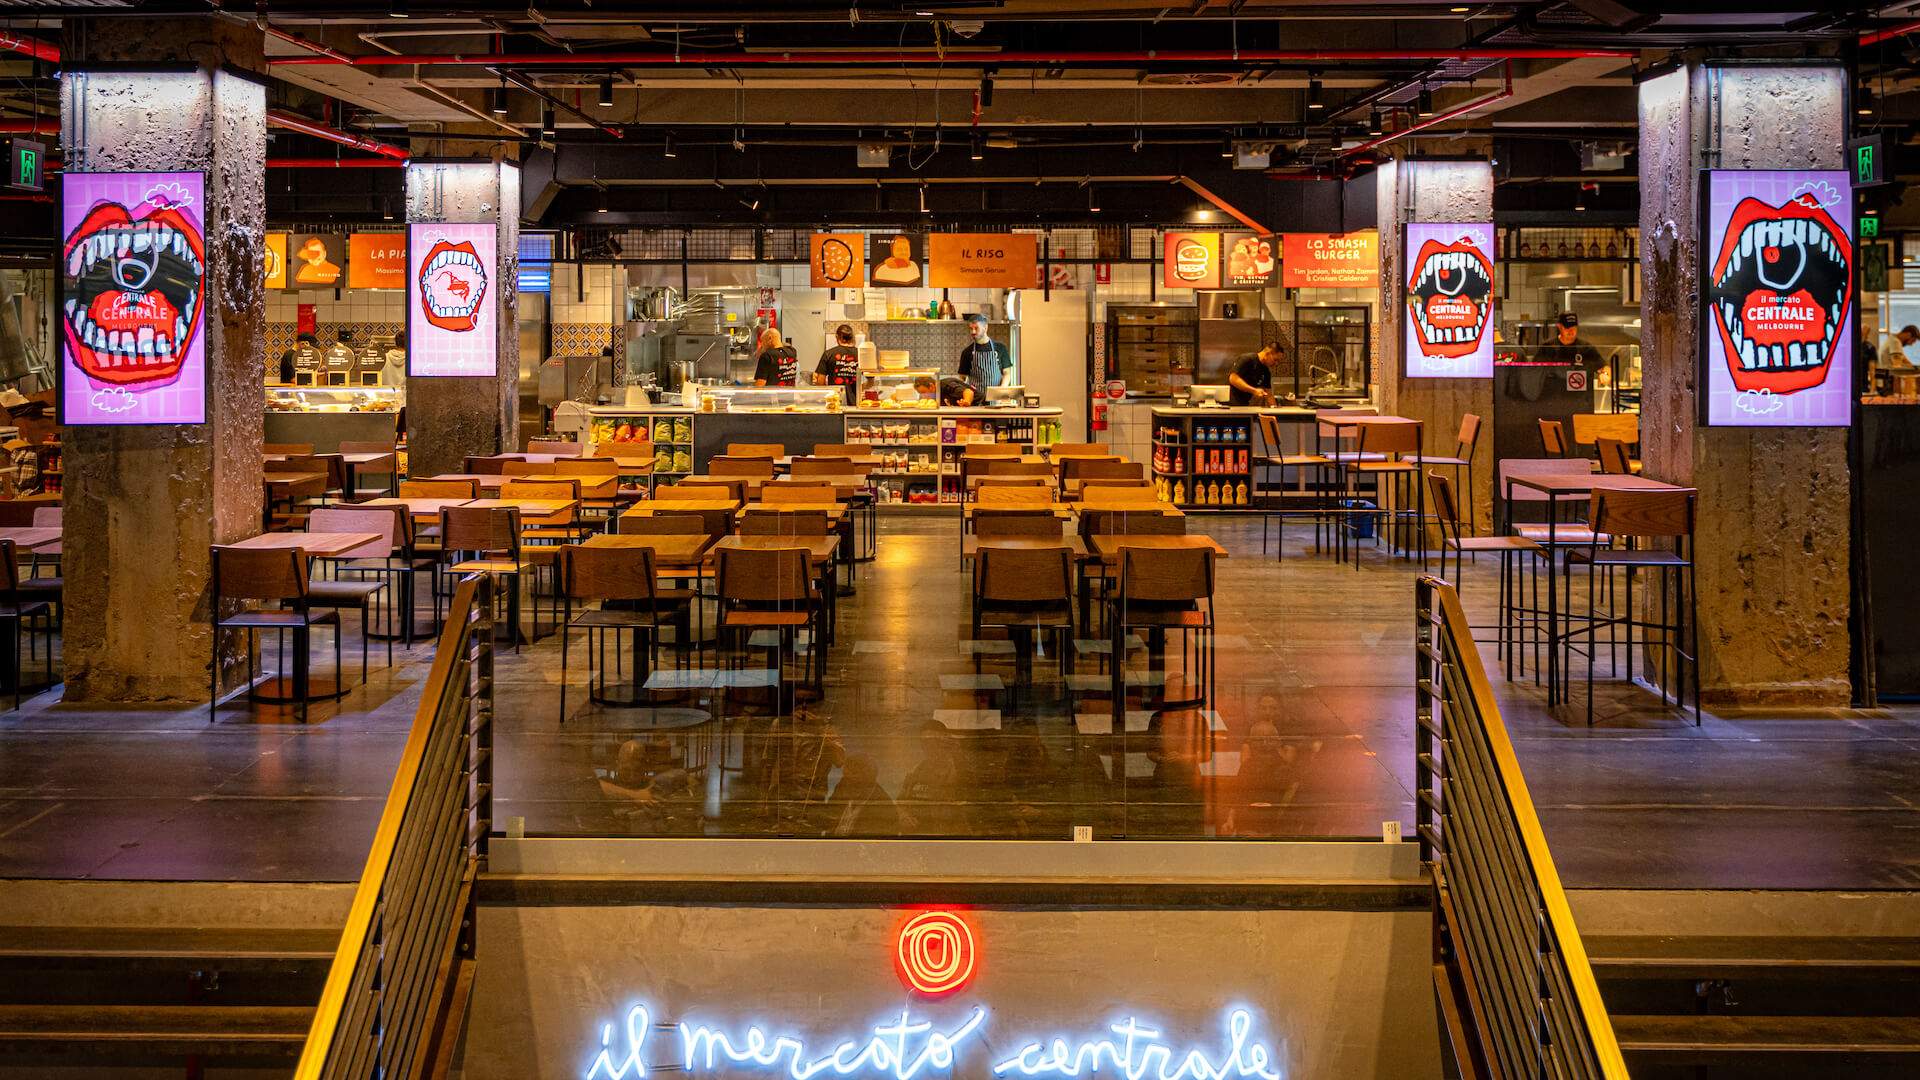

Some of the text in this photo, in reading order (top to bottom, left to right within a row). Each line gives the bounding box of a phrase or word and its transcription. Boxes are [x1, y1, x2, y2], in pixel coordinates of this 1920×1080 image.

[1307, 239, 1367, 249] LO SMASH
[371, 249, 385, 259] LA
[962, 248, 1004, 258] IL RISO
[1314, 250, 1361, 260] BURGER
[113, 292, 157, 308] CENTRALE
[1761, 295, 1767, 303] il
[102, 306, 168, 320] CENTRALE
[1430, 305, 1471, 314] CENTRALE
[1747, 306, 1815, 321] CENTRALE
[1757, 323, 1805, 331] MELBOURNE
[586, 1004, 1280, 1080] il mercato centrale
